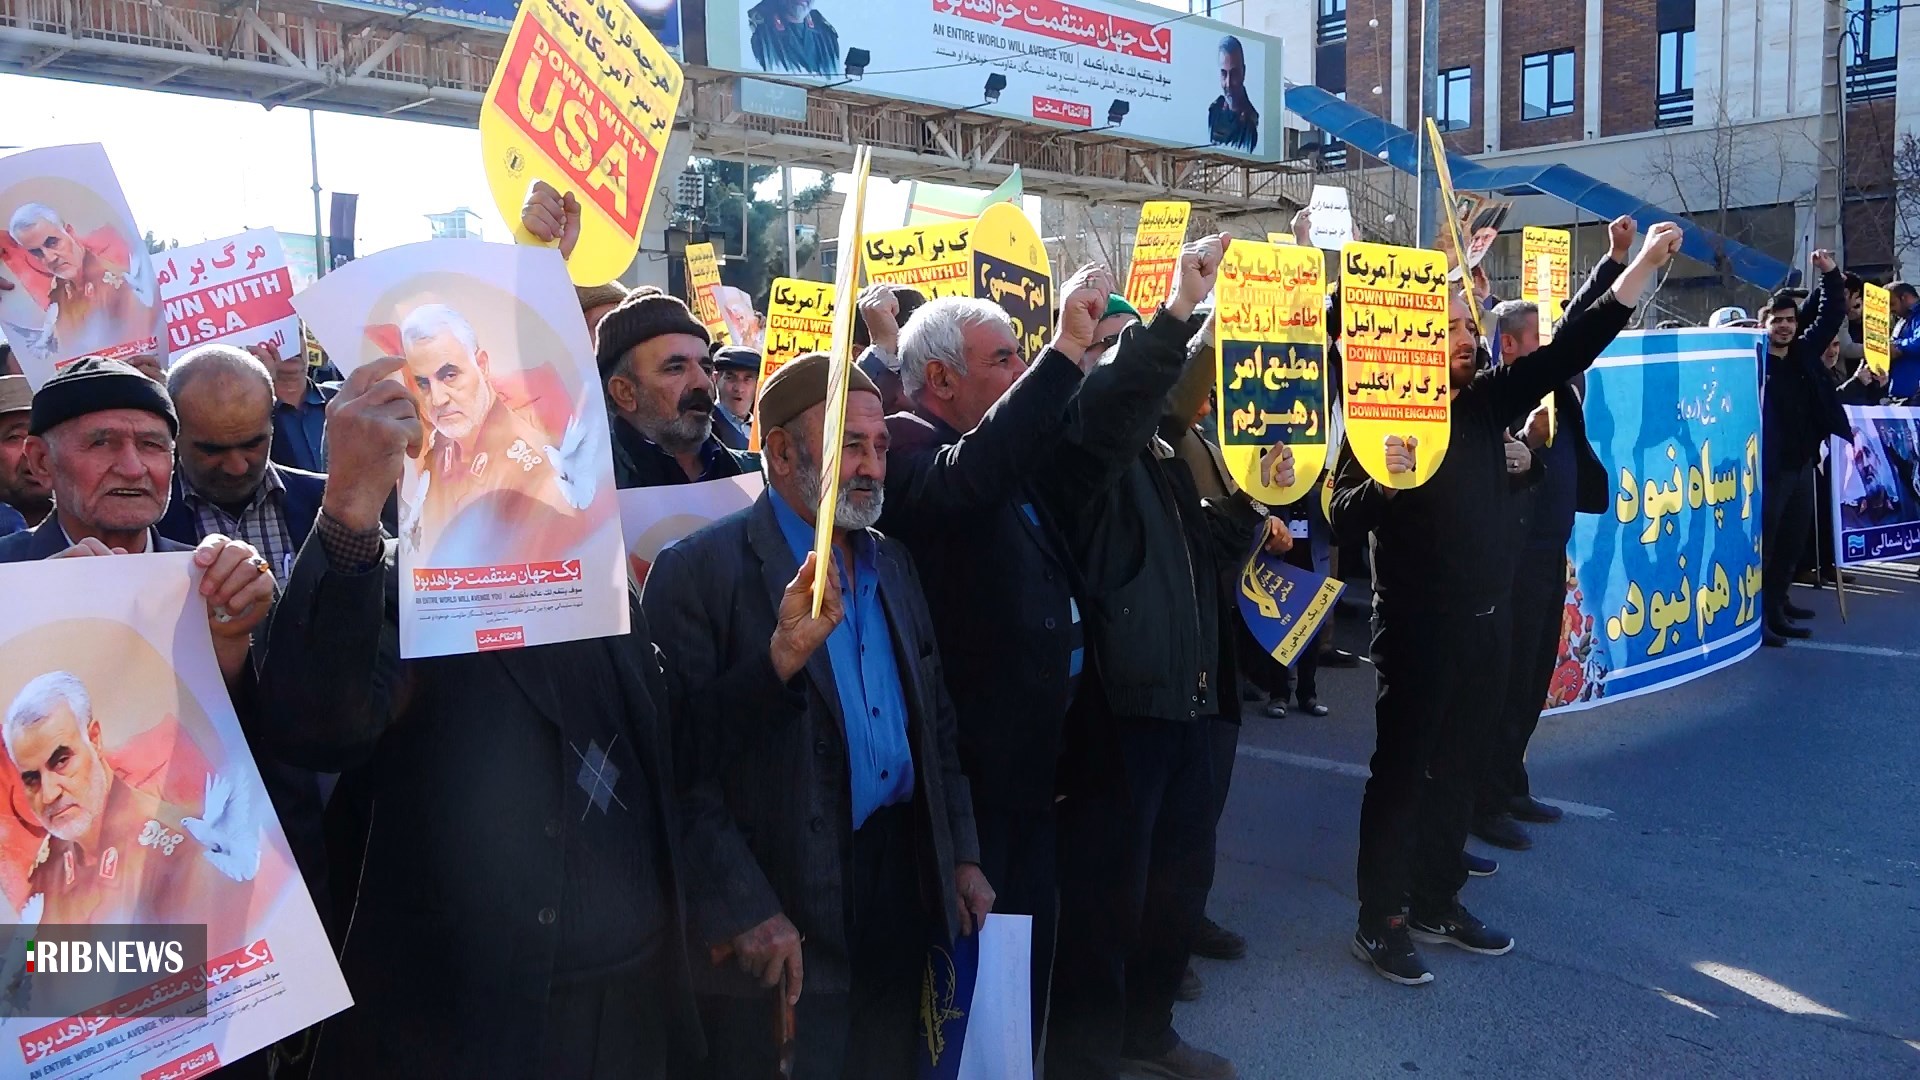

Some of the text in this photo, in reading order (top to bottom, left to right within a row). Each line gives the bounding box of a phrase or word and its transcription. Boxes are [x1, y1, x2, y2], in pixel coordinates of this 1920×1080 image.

[1024, 5, 1096, 38] منتقمت
[1096, 15, 1138, 56] جهان
[933, 23, 1073, 64] AN ENTIRE WORLD WILL AVENGE YOU
[1139, 26, 1169, 63] یک
[533, 33, 648, 163] DOWN WITH
[517, 51, 629, 220] USA
[650, 117, 666, 135] بر
[211, 241, 266, 271] مرگ
[866, 231, 926, 267] آمریکا
[929, 238, 946, 262] بر
[190, 257, 209, 286] بر
[873, 269, 919, 285] DOWN
[919, 264, 955, 282] WITH
[1346, 252, 1446, 292] مرگ بر آمریکا
[164, 272, 282, 324] WN WITH
[774, 285, 826, 314] آمریکا
[1129, 273, 1168, 310] USA
[1346, 287, 1444, 311] DOWN WITH U.S.A
[170, 310, 248, 347] U.S.A
[772, 315, 809, 331] DOWN
[1262, 304, 1276, 333] از
[1279, 305, 1322, 328] اطاعت
[1346, 309, 1446, 345] مرگ بر اسرائیل
[1229, 345, 1319, 390] مطیع امر
[1348, 346, 1445, 366] DOWN WITH ISRAEL
[1347, 371, 1395, 396] انگلیس
[1399, 380, 1412, 399] بر
[1232, 399, 1319, 437] رهبریم
[1350, 405, 1446, 420] DOWN WITH ENGLAND
[1616, 445, 1684, 544] نبود
[1689, 438, 1737, 529] سپاه
[1871, 531, 1903, 556] شمالی
[430, 569, 465, 591] خواهد
[465, 567, 517, 585] منتقمت
[518, 563, 552, 584] جهان
[553, 560, 580, 580] یک
[1695, 562, 1731, 640] هم
[236, 939, 273, 968] یک
[191, 962, 236, 993] جهان
[55, 1010, 114, 1045] خواهد
[25, 1036, 56, 1061] بود
[74, 1043, 105, 1062] WORLD
[106, 1034, 126, 1049] WILL
